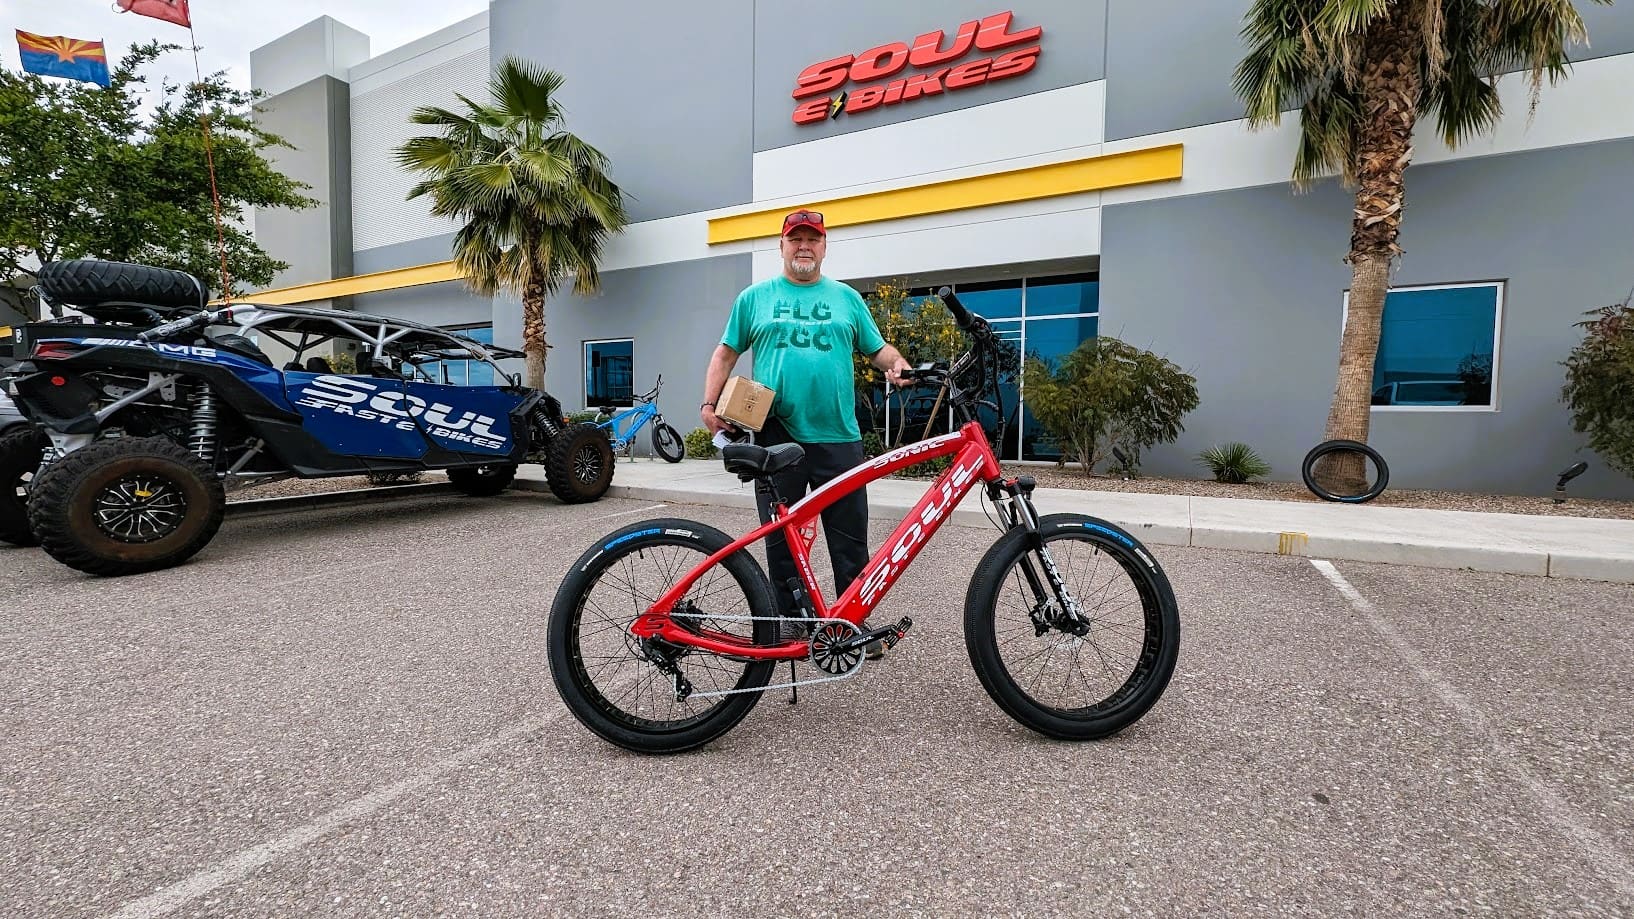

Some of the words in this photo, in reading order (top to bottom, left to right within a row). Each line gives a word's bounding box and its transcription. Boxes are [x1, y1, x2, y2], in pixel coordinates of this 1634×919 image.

[792, 10, 1042, 99] SOUL
[792, 96, 831, 125] E
[845, 45, 1041, 114] BIKES
[773, 298, 832, 321] FLG
[301, 375, 507, 442] SOUL
[872, 440, 945, 470] SONIC
[860, 454, 983, 606] SOUL
